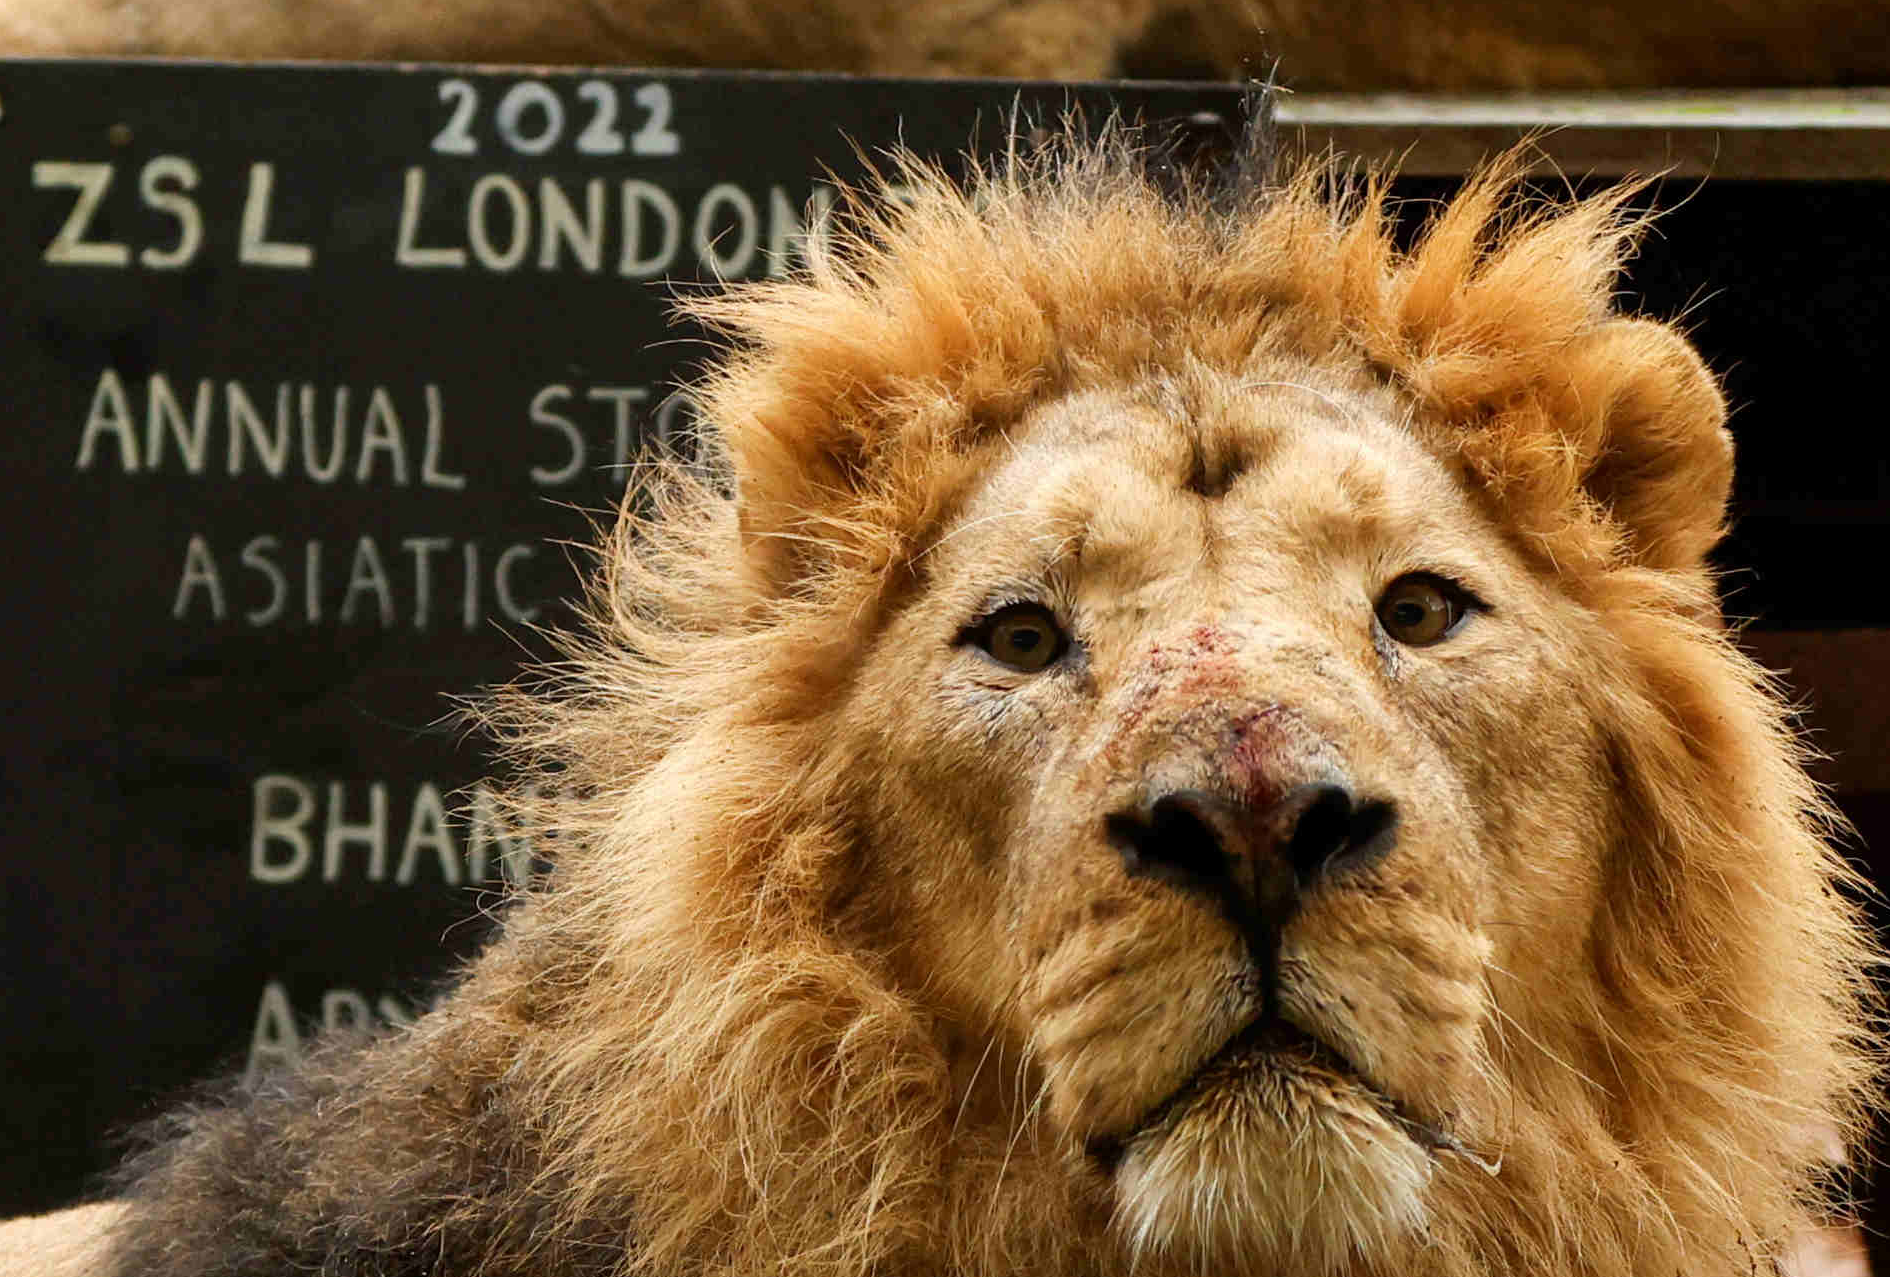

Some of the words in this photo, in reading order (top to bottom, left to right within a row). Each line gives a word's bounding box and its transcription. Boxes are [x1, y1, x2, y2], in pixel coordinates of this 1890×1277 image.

[430, 80, 681, 156] 2022
[31, 154, 314, 270] ZSL
[394, 166, 832, 280] LONDON
[75, 367, 467, 490] ANNUAL
[171, 534, 543, 631] ASIATIC
